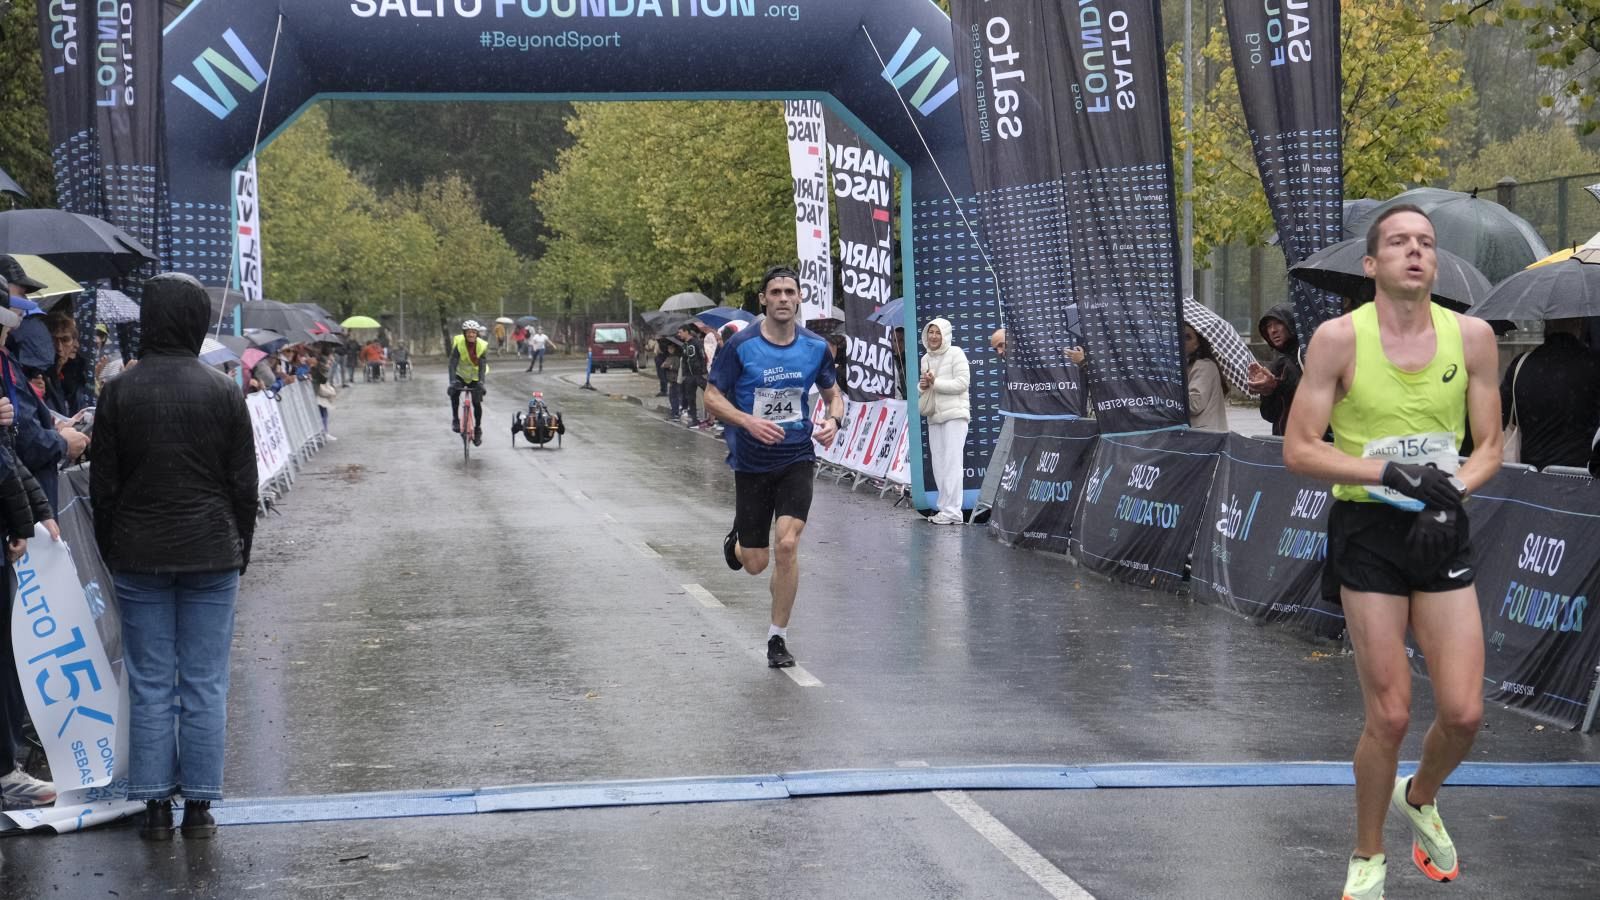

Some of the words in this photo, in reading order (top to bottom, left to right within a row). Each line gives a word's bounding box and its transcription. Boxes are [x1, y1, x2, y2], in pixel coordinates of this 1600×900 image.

[495, 0, 756, 18] FOUNDATION
[763, 4, 800, 21] .org
[479, 31, 621, 51] #BeyondSport
[763, 366, 784, 376] SALTO
[764, 401, 793, 416] 244
[1368, 446, 1398, 457] SALTO
[1398, 437, 1428, 458] 15K
[1127, 464, 1160, 490] SALTO
[1290, 488, 1328, 520] SALTO
[1518, 532, 1565, 577] SALTO
